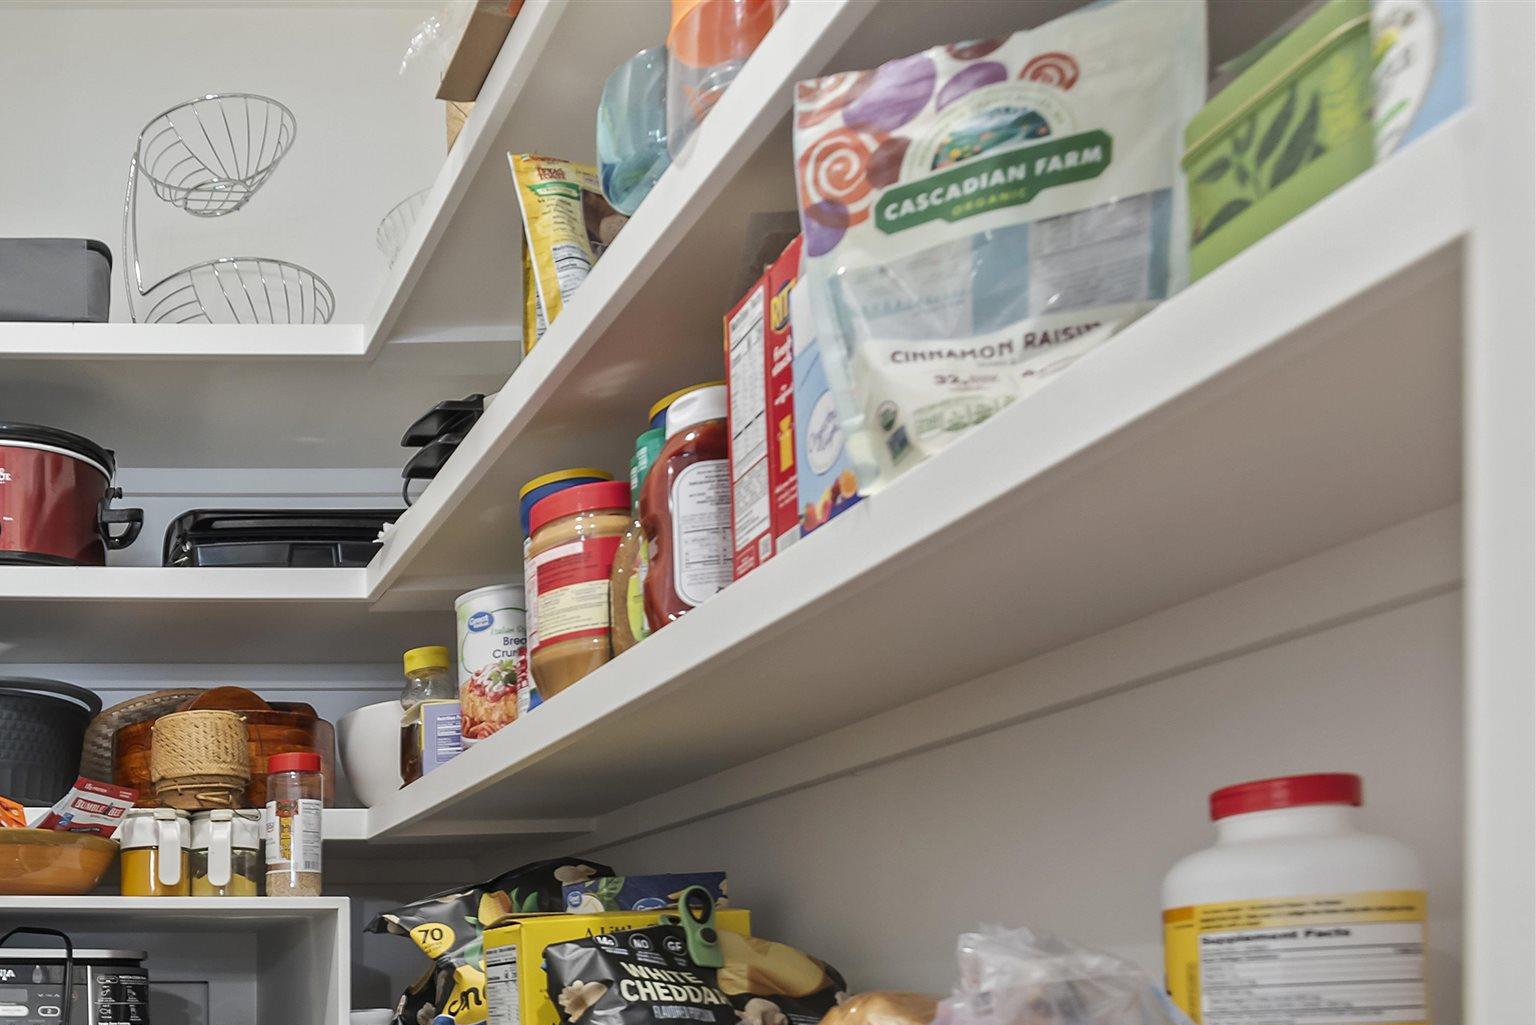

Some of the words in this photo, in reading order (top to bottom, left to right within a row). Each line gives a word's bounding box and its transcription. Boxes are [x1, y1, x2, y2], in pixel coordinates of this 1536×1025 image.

[883, 163, 1027, 222] CASCADIAN
[1034, 144, 1103, 176] FARM
[890, 340, 1014, 364] CINNAMON
[1023, 320, 1103, 349] RAISIN
[74, 799, 104, 814] BUMBLE
[418, 927, 444, 944] 70
[632, 938, 650, 950] NO
[667, 941, 684, 951] GF
[620, 961, 704, 985] WHITE
